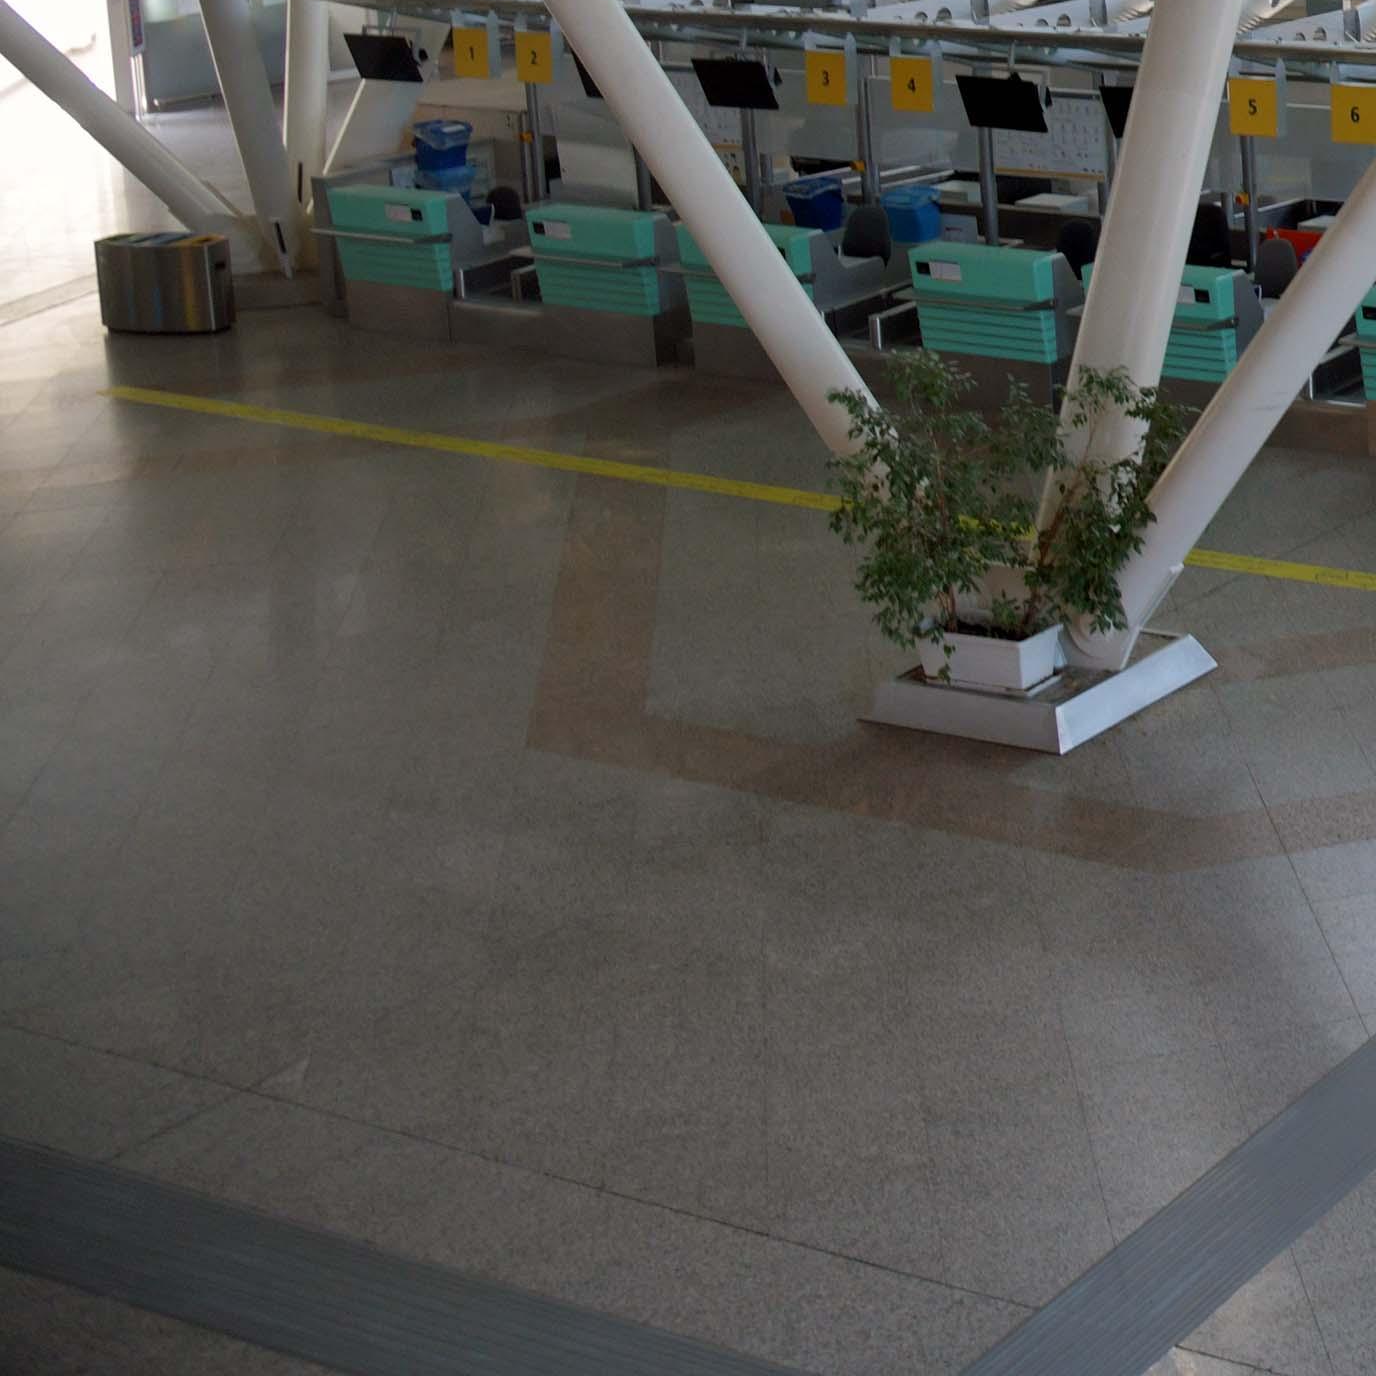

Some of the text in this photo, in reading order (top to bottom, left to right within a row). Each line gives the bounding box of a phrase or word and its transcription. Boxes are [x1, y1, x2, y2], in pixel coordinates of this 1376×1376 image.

[468, 47, 475, 62] 1
[530, 51, 538, 65] 2
[822, 71, 831, 86] 3
[907, 78, 916, 93] 4
[1248, 99, 1258, 116] 5
[1350, 106, 1360, 124] 6
